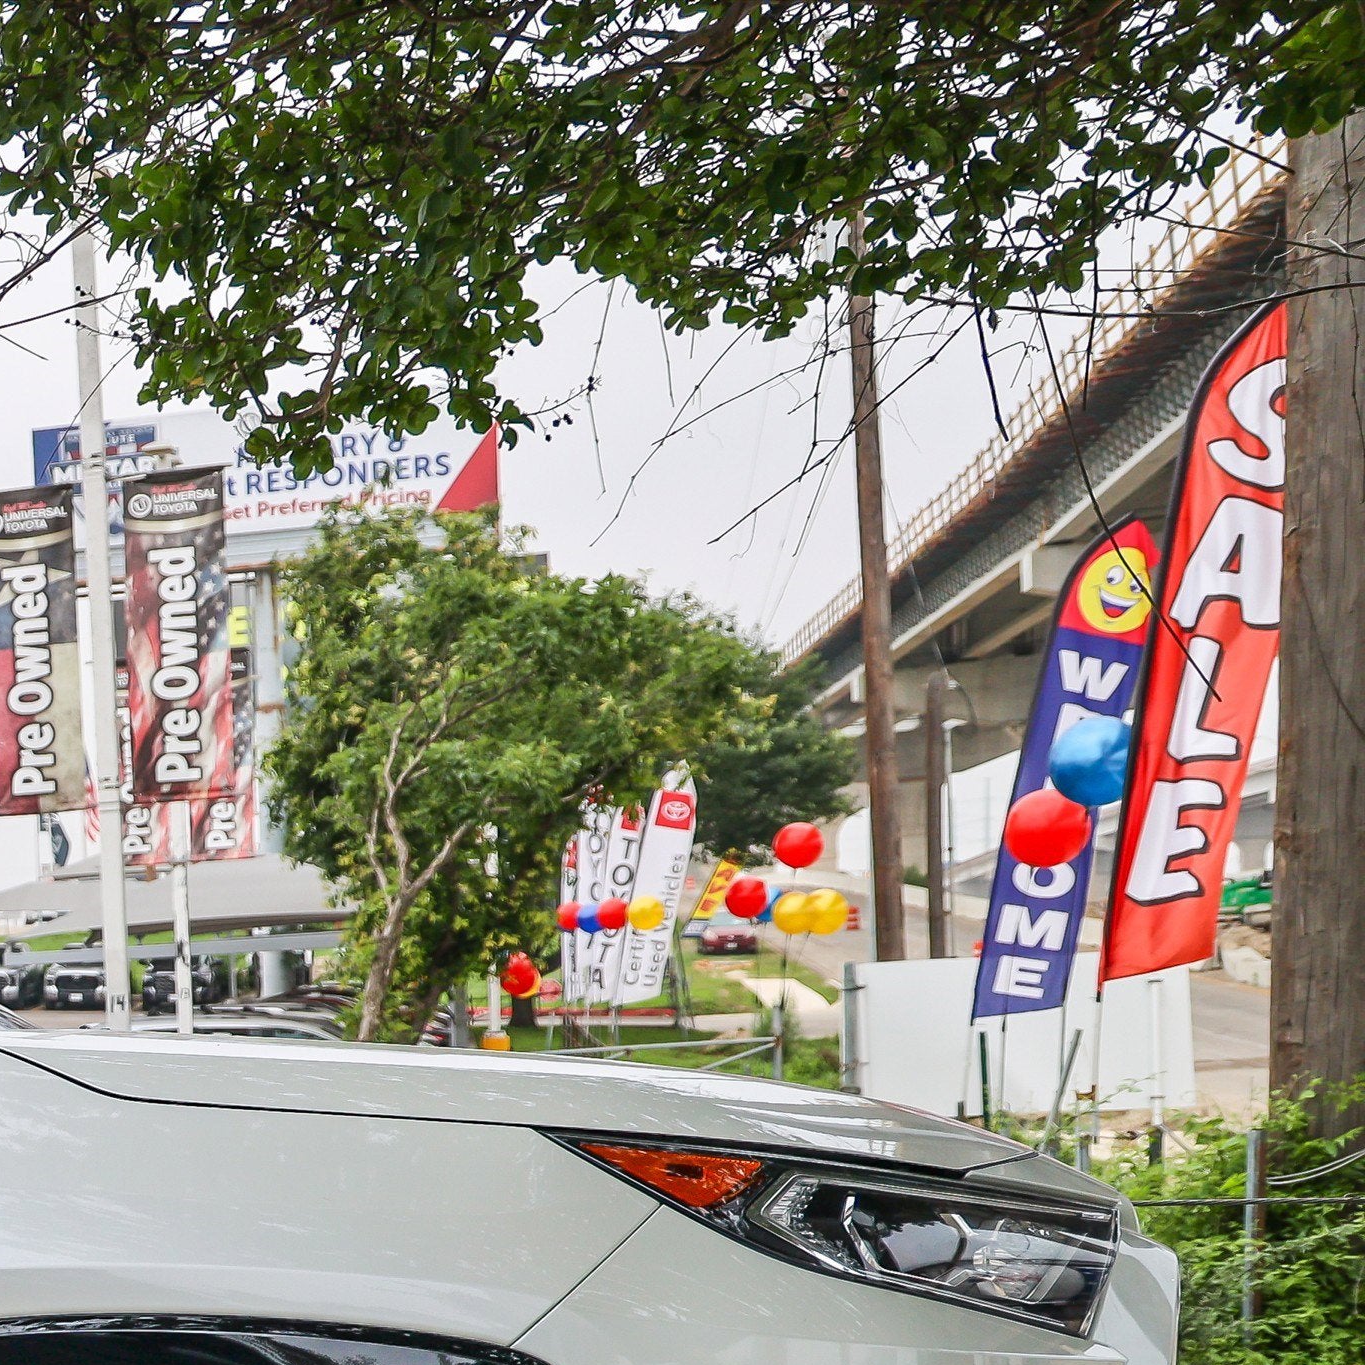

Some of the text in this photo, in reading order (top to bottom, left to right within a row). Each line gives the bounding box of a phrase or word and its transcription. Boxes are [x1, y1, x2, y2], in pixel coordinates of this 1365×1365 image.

[52, 454, 173, 486] MITAR
[3, 506, 68, 523] UNIVERSAL
[151, 488, 218, 503] UNIVERSAL
[152, 501, 198, 517] TOYOTA
[257, 491, 354, 517] Preferrd
[4, 519, 48, 534] TOYOTA
[0, 562, 54, 716] Owned
[148, 545, 201, 701] Owned
[1124, 356, 1287, 906] SALE
[12, 721, 57, 797] Pre
[154, 707, 203, 784] Pre
[122, 806, 152, 855] Pre
[204, 799, 236, 852] Pre
[991, 648, 1130, 999] WOME
[642, 938, 667, 988] Used
